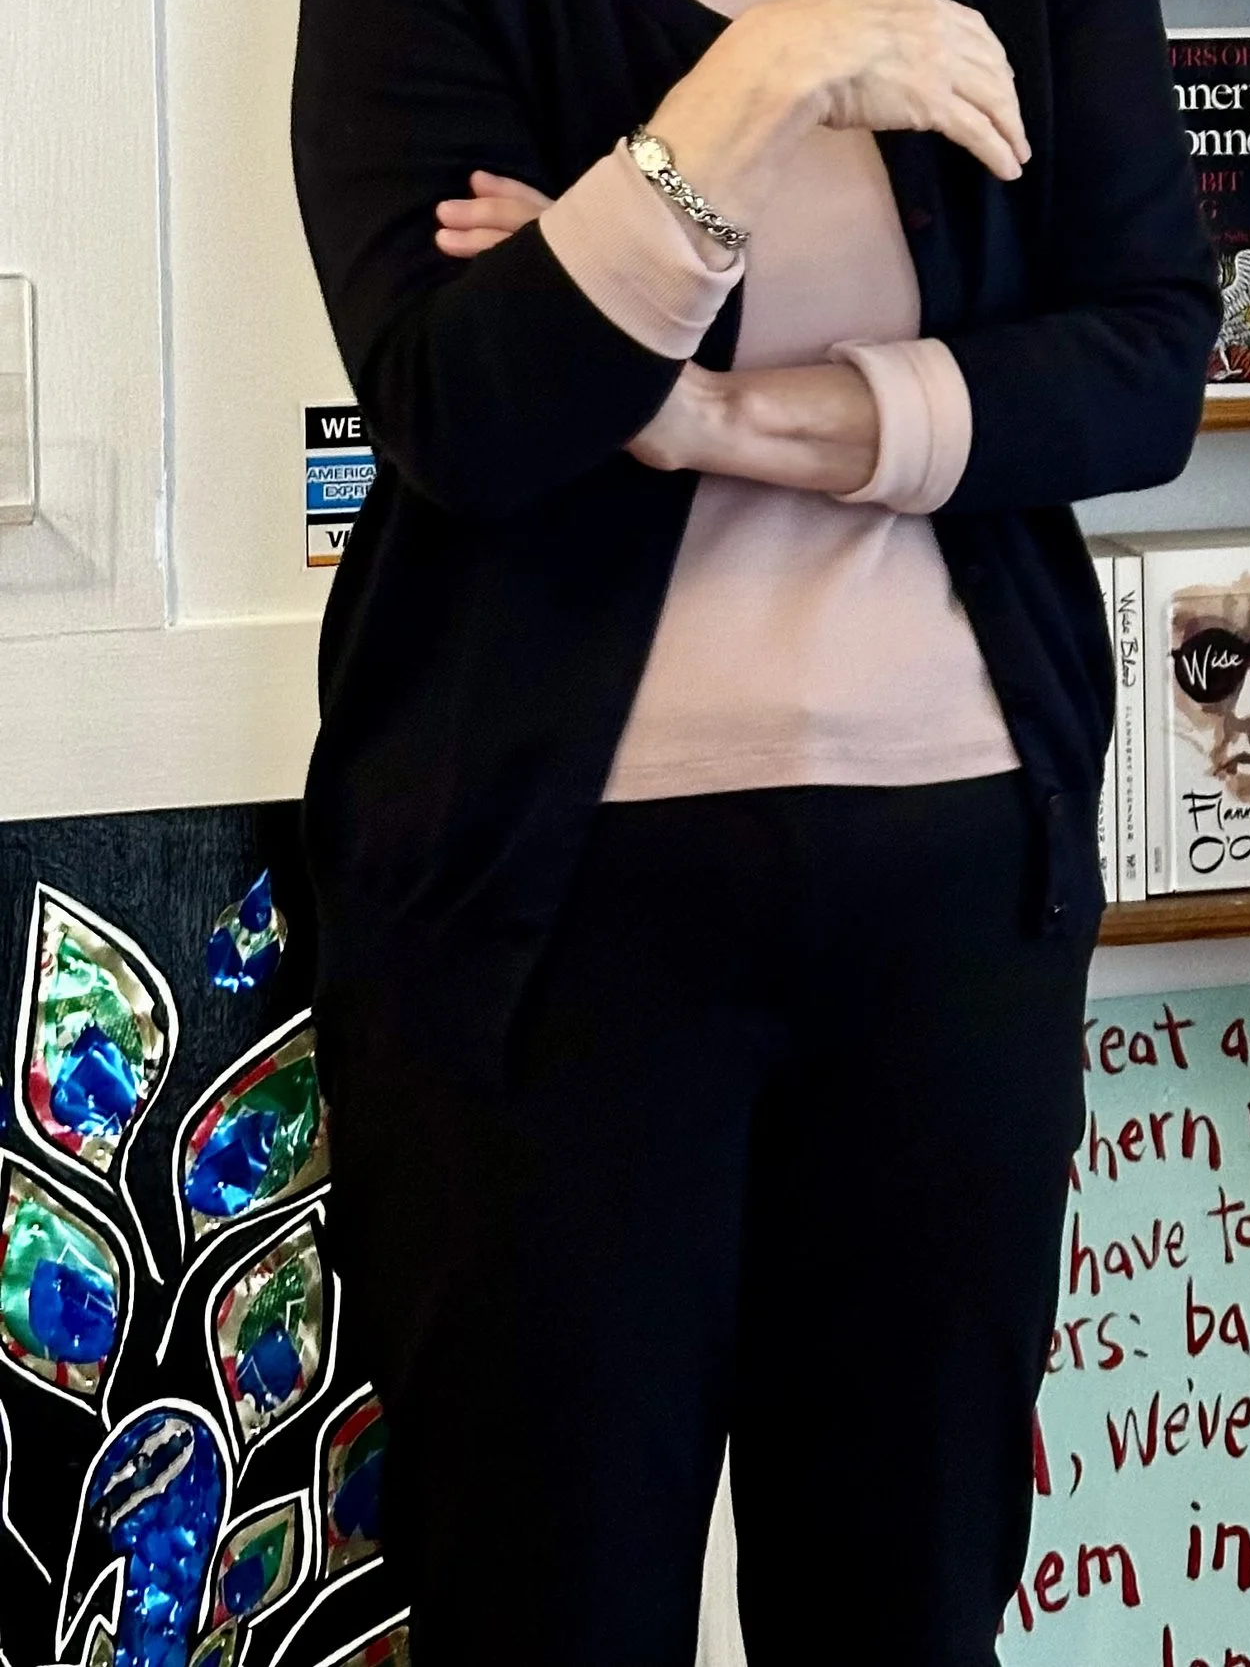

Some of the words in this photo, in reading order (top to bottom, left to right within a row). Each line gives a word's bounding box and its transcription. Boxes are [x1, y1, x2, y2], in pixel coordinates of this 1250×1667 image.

[321, 416, 362, 439] WE
[307, 466, 377, 481] AMERICA
[1182, 647, 1244, 691] Wise
[1082, 1001, 1196, 1075] reat
[1068, 1211, 1189, 1295] have
